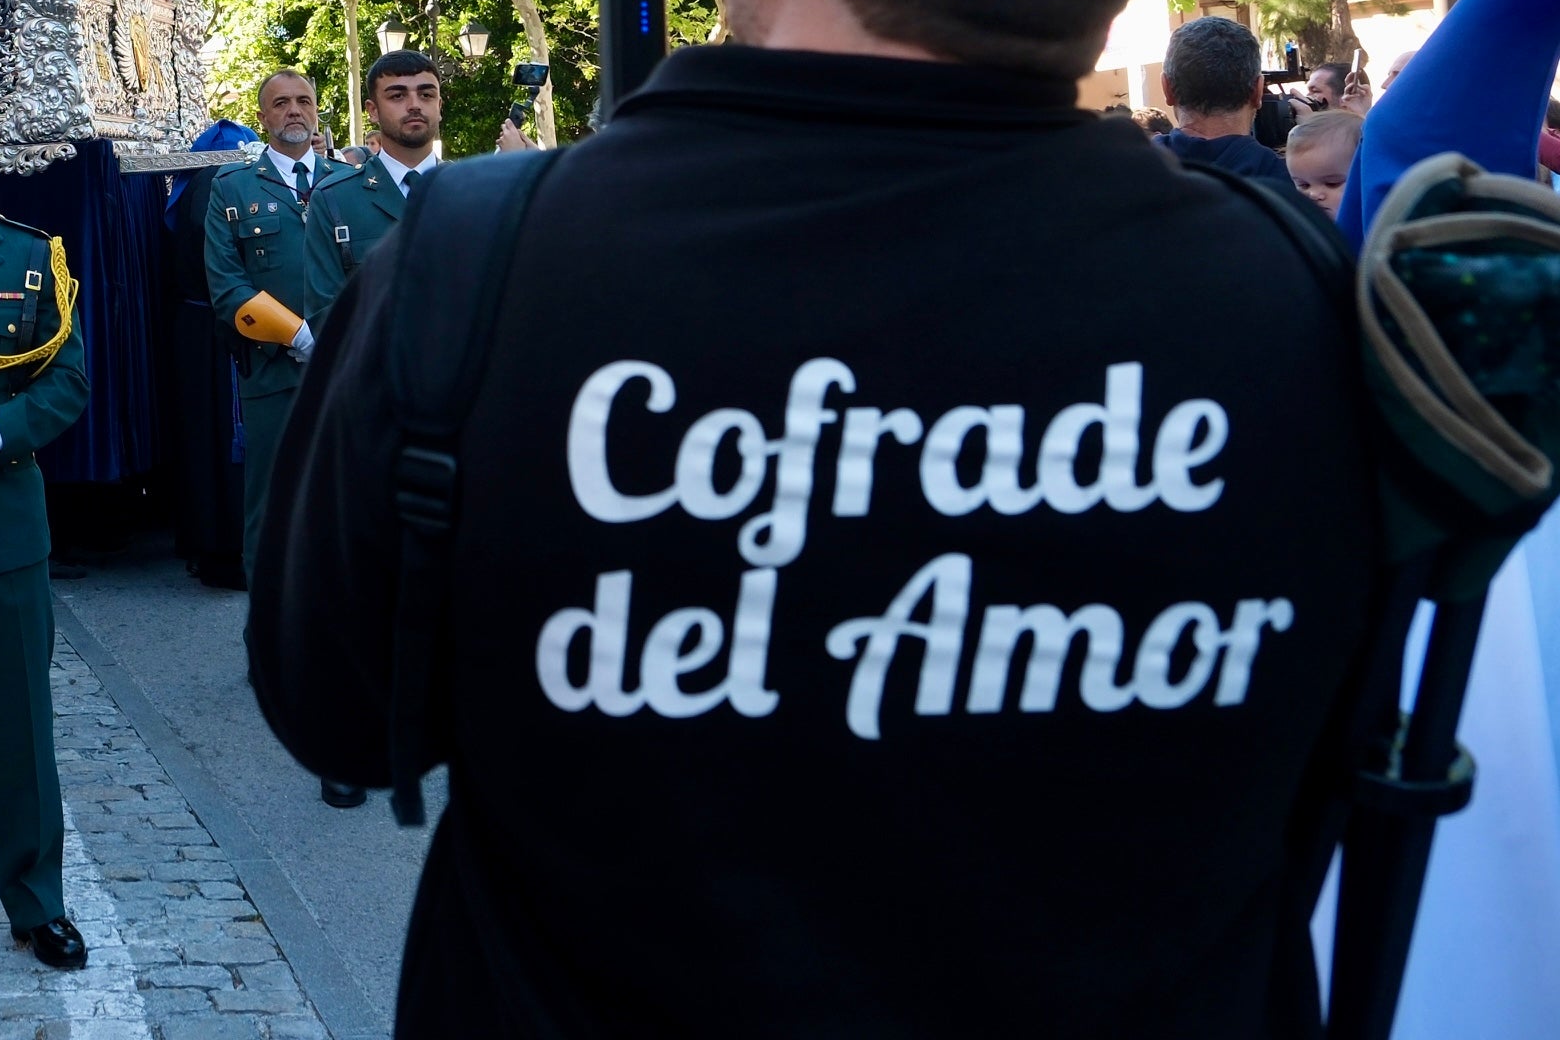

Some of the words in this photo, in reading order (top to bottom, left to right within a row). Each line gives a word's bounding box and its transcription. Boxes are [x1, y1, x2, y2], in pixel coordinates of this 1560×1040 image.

[568, 357, 1228, 567] Cofrade
[536, 567, 780, 717] del
[826, 553, 1294, 739] Amor
